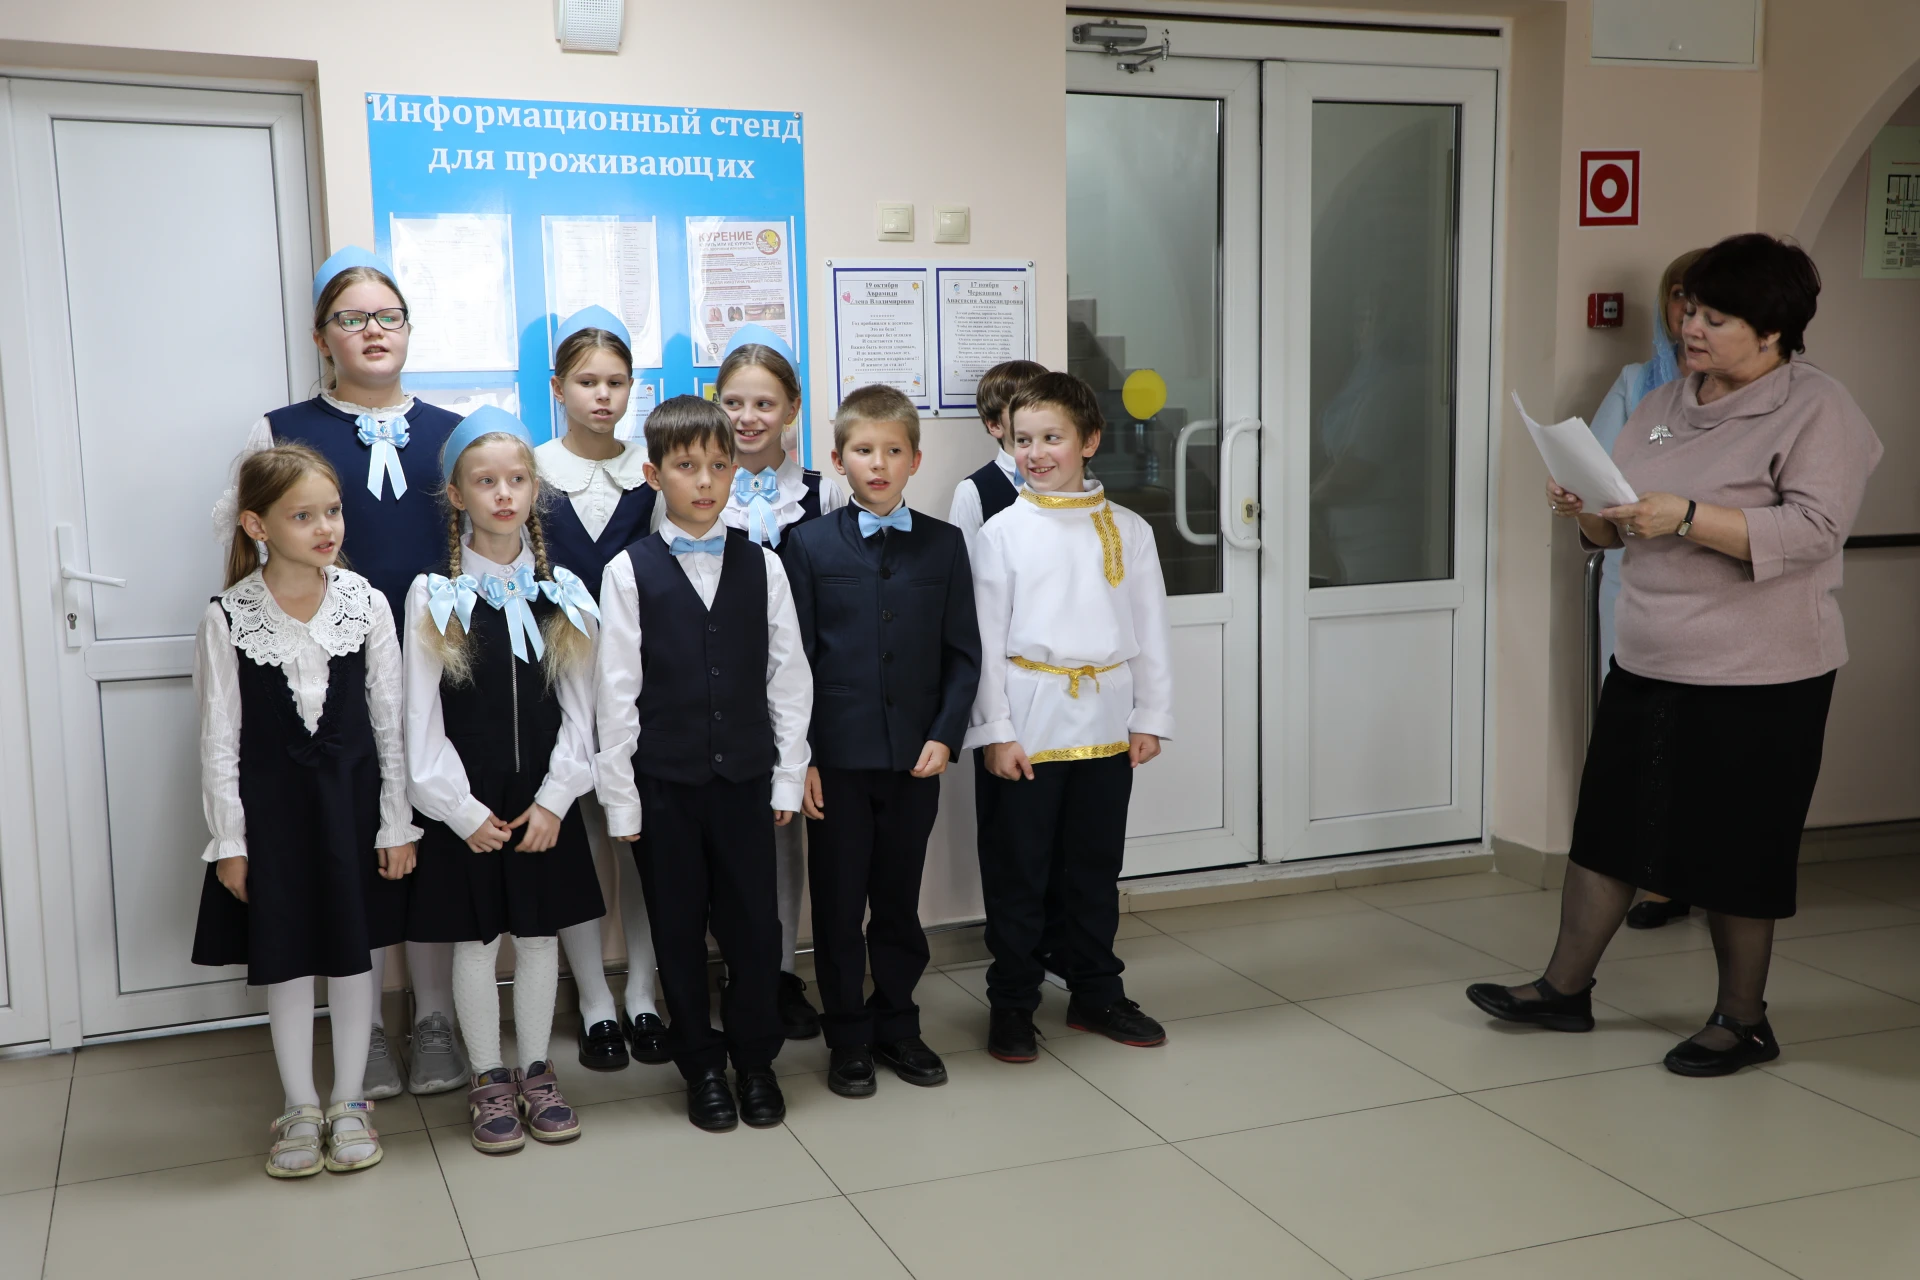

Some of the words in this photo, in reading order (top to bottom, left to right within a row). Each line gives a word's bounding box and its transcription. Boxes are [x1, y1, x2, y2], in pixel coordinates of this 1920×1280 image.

[370, 94, 702, 135] Информационный
[710, 116, 801, 144] стенд
[428, 148, 496, 174] для
[505, 150, 755, 182] проживающих
[698, 230, 753, 242] КУРЕНИЕ
